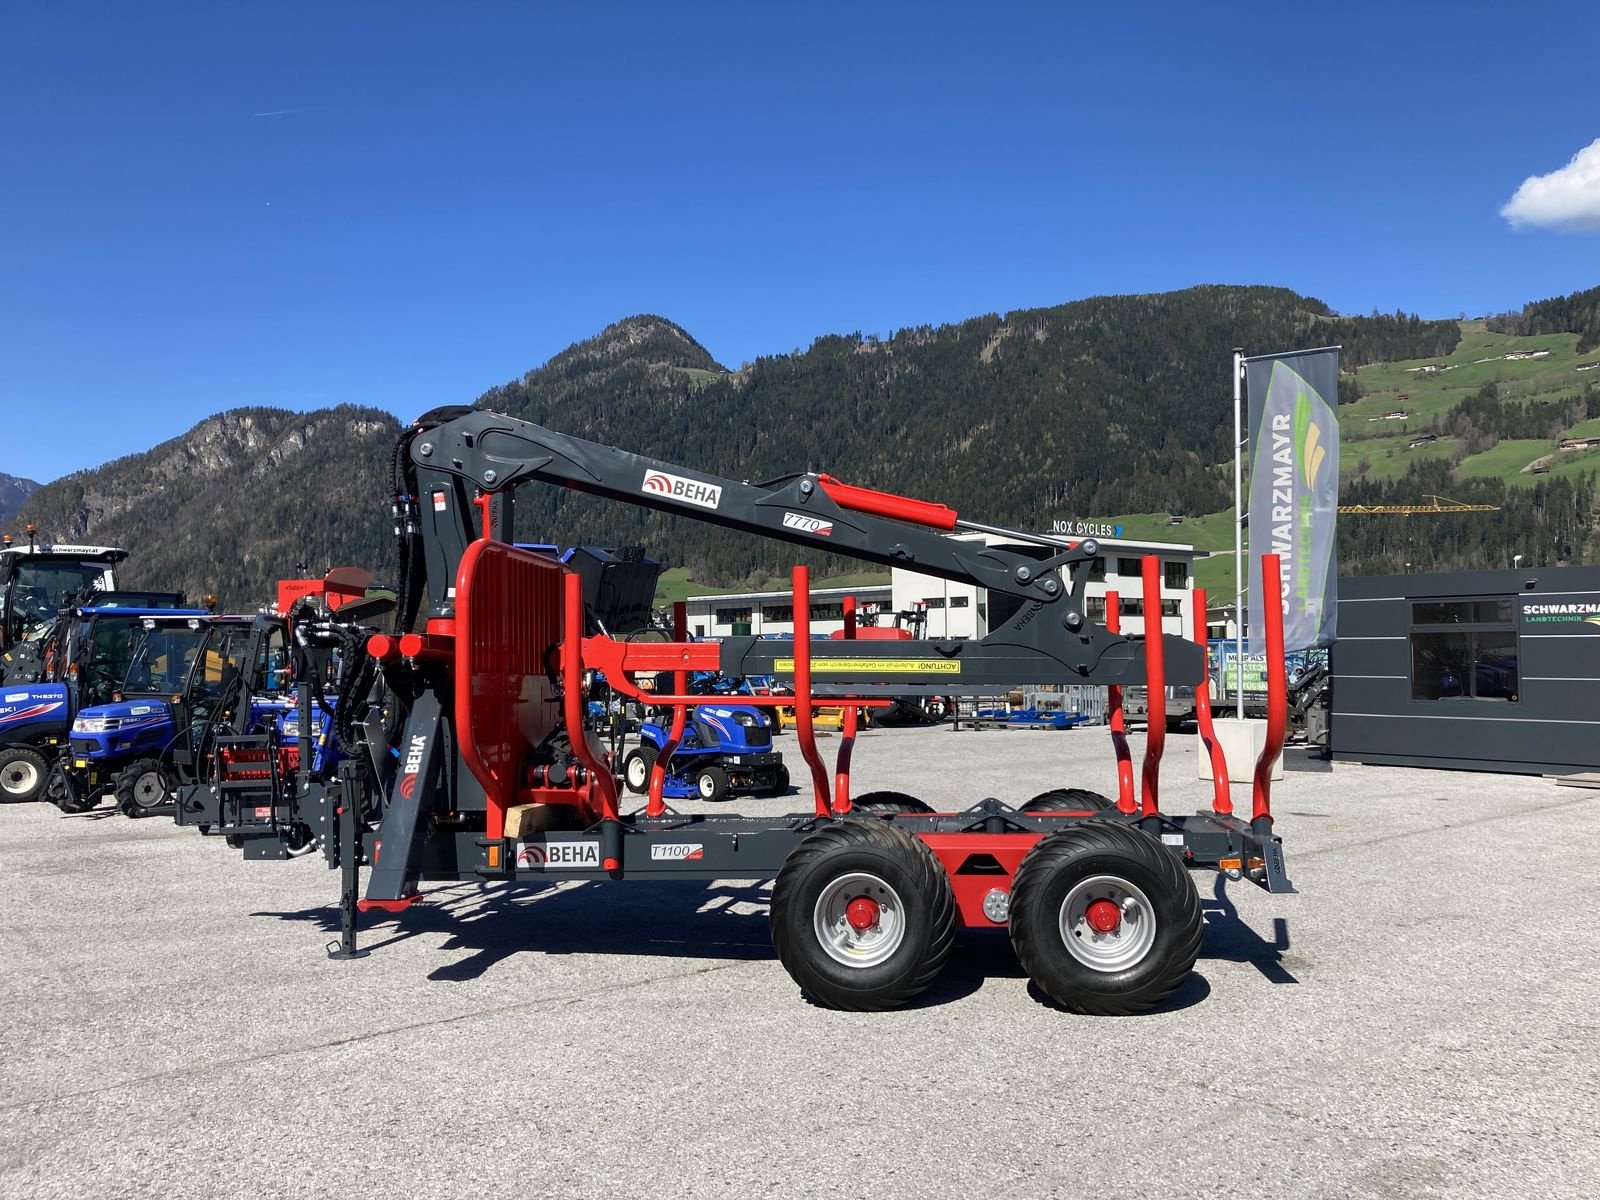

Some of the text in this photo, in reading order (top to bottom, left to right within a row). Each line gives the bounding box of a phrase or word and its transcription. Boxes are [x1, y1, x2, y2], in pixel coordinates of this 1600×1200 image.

[673, 480, 717, 505] BEHA
[784, 513, 820, 531] 7770
[1053, 520, 1112, 536] NOX CYCLES
[38, 546, 98, 555] schwarzmayr.at
[1012, 610, 1035, 631] BEHA
[1525, 615, 1582, 623] LANDTECHNIK
[918, 662, 957, 670] ACHTUNG!
[404, 735, 427, 774] BEHA
[550, 845, 597, 863] BEHA
[652, 845, 690, 857] T1100
